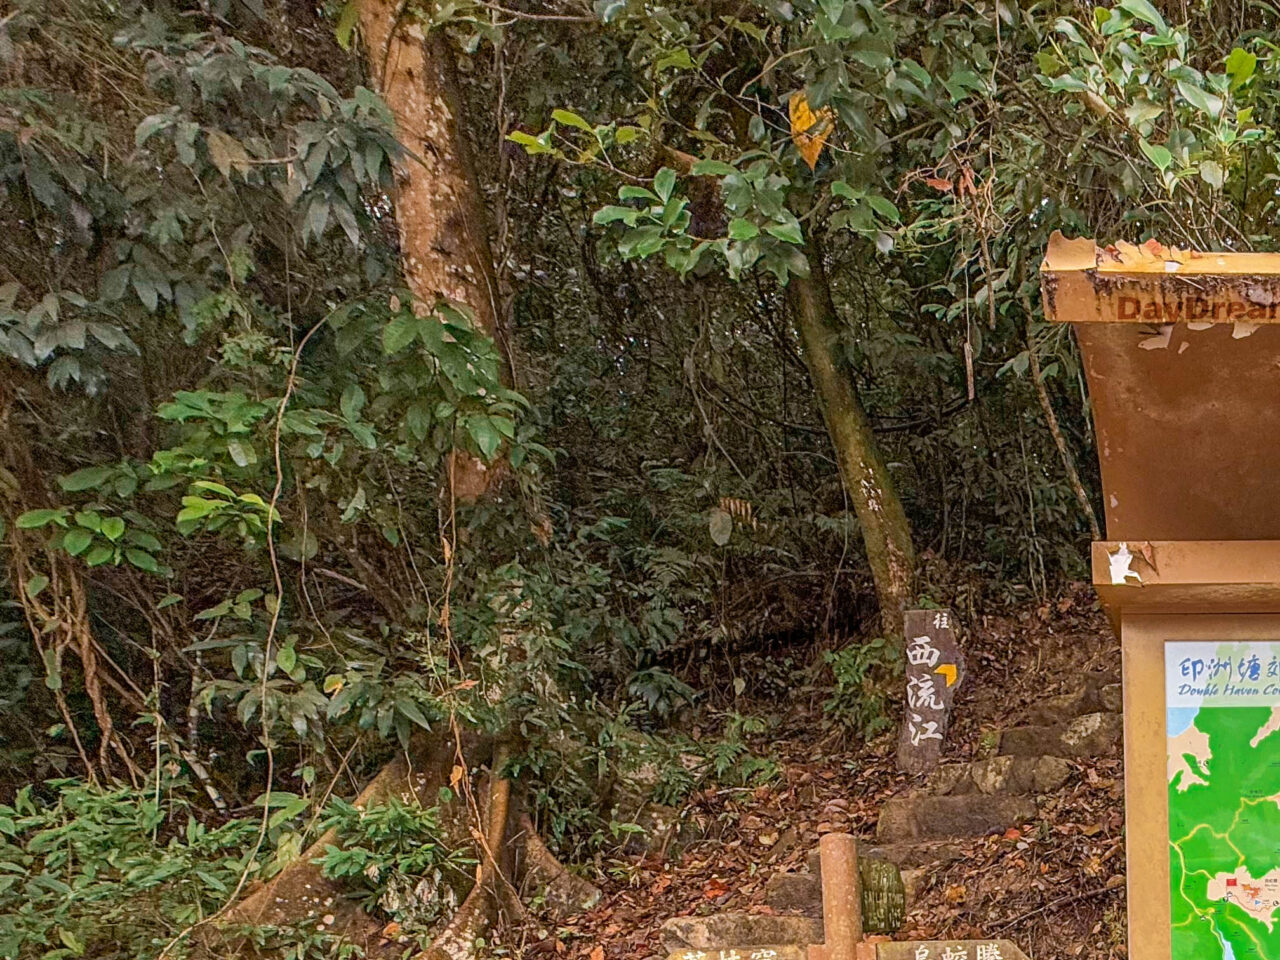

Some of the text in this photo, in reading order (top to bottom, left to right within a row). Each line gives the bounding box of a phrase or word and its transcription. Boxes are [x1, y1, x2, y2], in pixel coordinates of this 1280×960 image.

[906, 636, 944, 746] 西流江
[1178, 683, 1219, 696] Double
[1223, 684, 1259, 695] Haven
